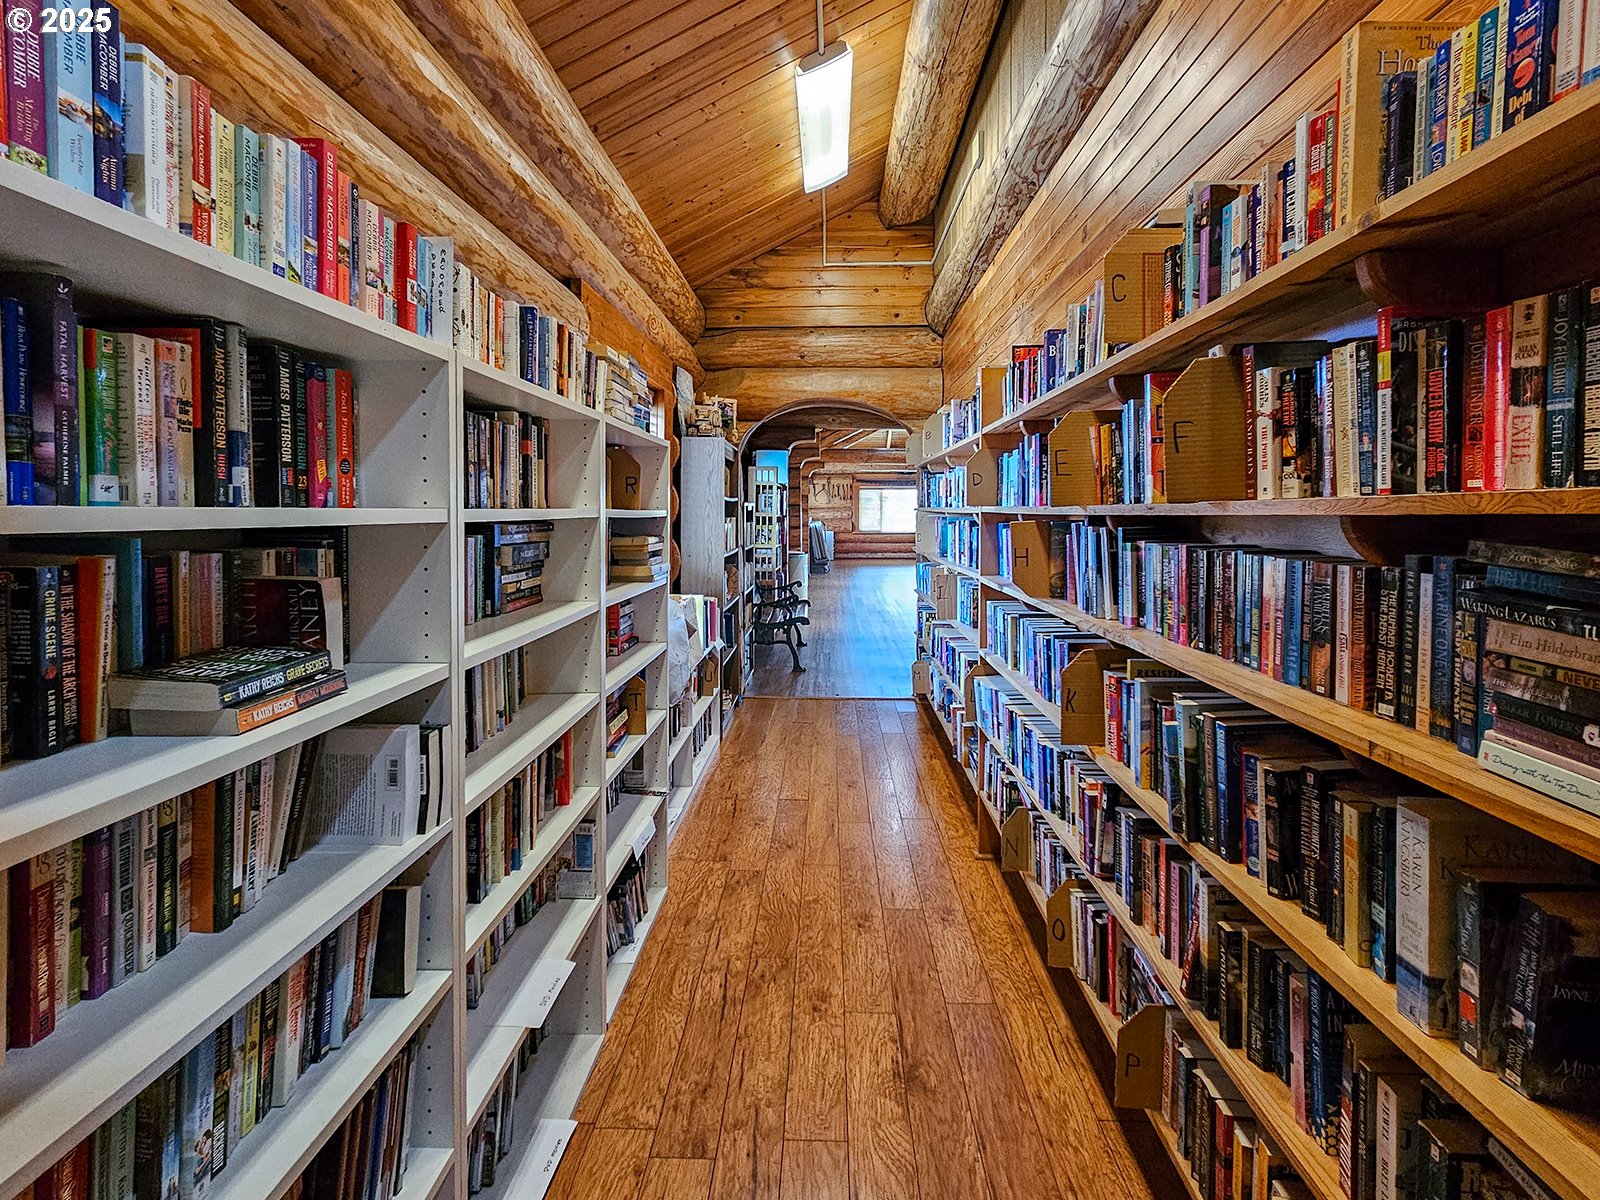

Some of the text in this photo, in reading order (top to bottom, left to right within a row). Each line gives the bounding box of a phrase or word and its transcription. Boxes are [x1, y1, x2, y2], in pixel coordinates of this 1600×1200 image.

[27, 30, 40, 81] DEBBIE
[109, 46, 117, 83] DEBBIE
[1450, 46, 1463, 131] The Class Menagerie
[16, 101, 25, 132] Brides
[24, 97, 34, 144] Manning
[102, 156, 110, 183] Nights
[110, 156, 118, 190] Autumn
[1310, 145, 1319, 175] COULTER
[1340, 114, 1352, 210] JIMMY CARTER
[1286, 175, 1296, 228] TOM CLANCY
[1112, 274, 1126, 302] C
[59, 320, 69, 400] FATAL HARVEST
[1552, 317, 1567, 394] JOY FIELDING
[1584, 342, 1600, 381] DECEIVER
[215, 344, 226, 448] JAMES PATTERSON
[1470, 340, 1483, 425] JOSEPH FINDER
[280, 366, 291, 462] JAMES PATTERSON
[296, 377, 307, 470] JAMES PATTERSON
[1428, 370, 1443, 443] COVER STORY
[926, 431, 931, 439] B
[1173, 421, 1194, 453] F
[1510, 415, 1532, 465] EXILE
[1551, 415, 1564, 477] STILL LIFE
[1583, 384, 1600, 471] FREDERICK FORSYTH
[217, 454, 226, 480] HUSH
[1055, 449, 1072, 476] E
[1427, 447, 1436, 478] FORBES
[1436, 448, 1444, 471] COLIN
[1474, 444, 1482, 478] COMPANY
[625, 477, 637, 494] R
[972, 473, 982, 486] D
[1014, 548, 1029, 567] H
[937, 586, 943, 600] J
[1313, 586, 1323, 632] HAMILTON
[44, 590, 57, 659] CRIME SCENE
[1354, 583, 1364, 645] LINDA HOWARD
[1378, 615, 1387, 646] BEAST
[1387, 590, 1397, 648] THE NUMBER
[1404, 571, 1415, 675] HEART-SHAPED BOX
[1435, 579, 1448, 668] MARINE ONE
[1459, 597, 1557, 630] WAKING LAZARUS
[60, 584, 77, 699] IN THE SHADOW OF THE ARCH
[239, 680, 263, 699] KATHY
[262, 672, 284, 690] REICHS
[705, 671, 712, 682] U
[914, 670, 920, 680] M
[1376, 649, 1386, 689] HEINLEIN
[47, 690, 56, 747] LARRY RAGLE
[629, 693, 642, 711] T
[1065, 688, 1076, 714] K
[1535, 710, 1582, 734] TOWERS
[292, 777, 305, 819] FRANKENSTEIN
[1553, 777, 1568, 792] Top
[1568, 782, 1593, 800] Down
[1300, 795, 1312, 856] FRANKENSTEIN
[1311, 800, 1320, 859] DEAN KOONTZ'S
[1005, 838, 1019, 856] N
[1400, 815, 1414, 904] KINGSBURY
[1412, 836, 1425, 896] KAREN
[247, 859, 257, 892] LIBRARY
[122, 912, 135, 976] QUICKSILVER
[1052, 918, 1066, 941] O
[1220, 989, 1226, 1001] 13
[1125, 1053, 1140, 1077] P
[212, 1120, 226, 1174] BACKSHOT
